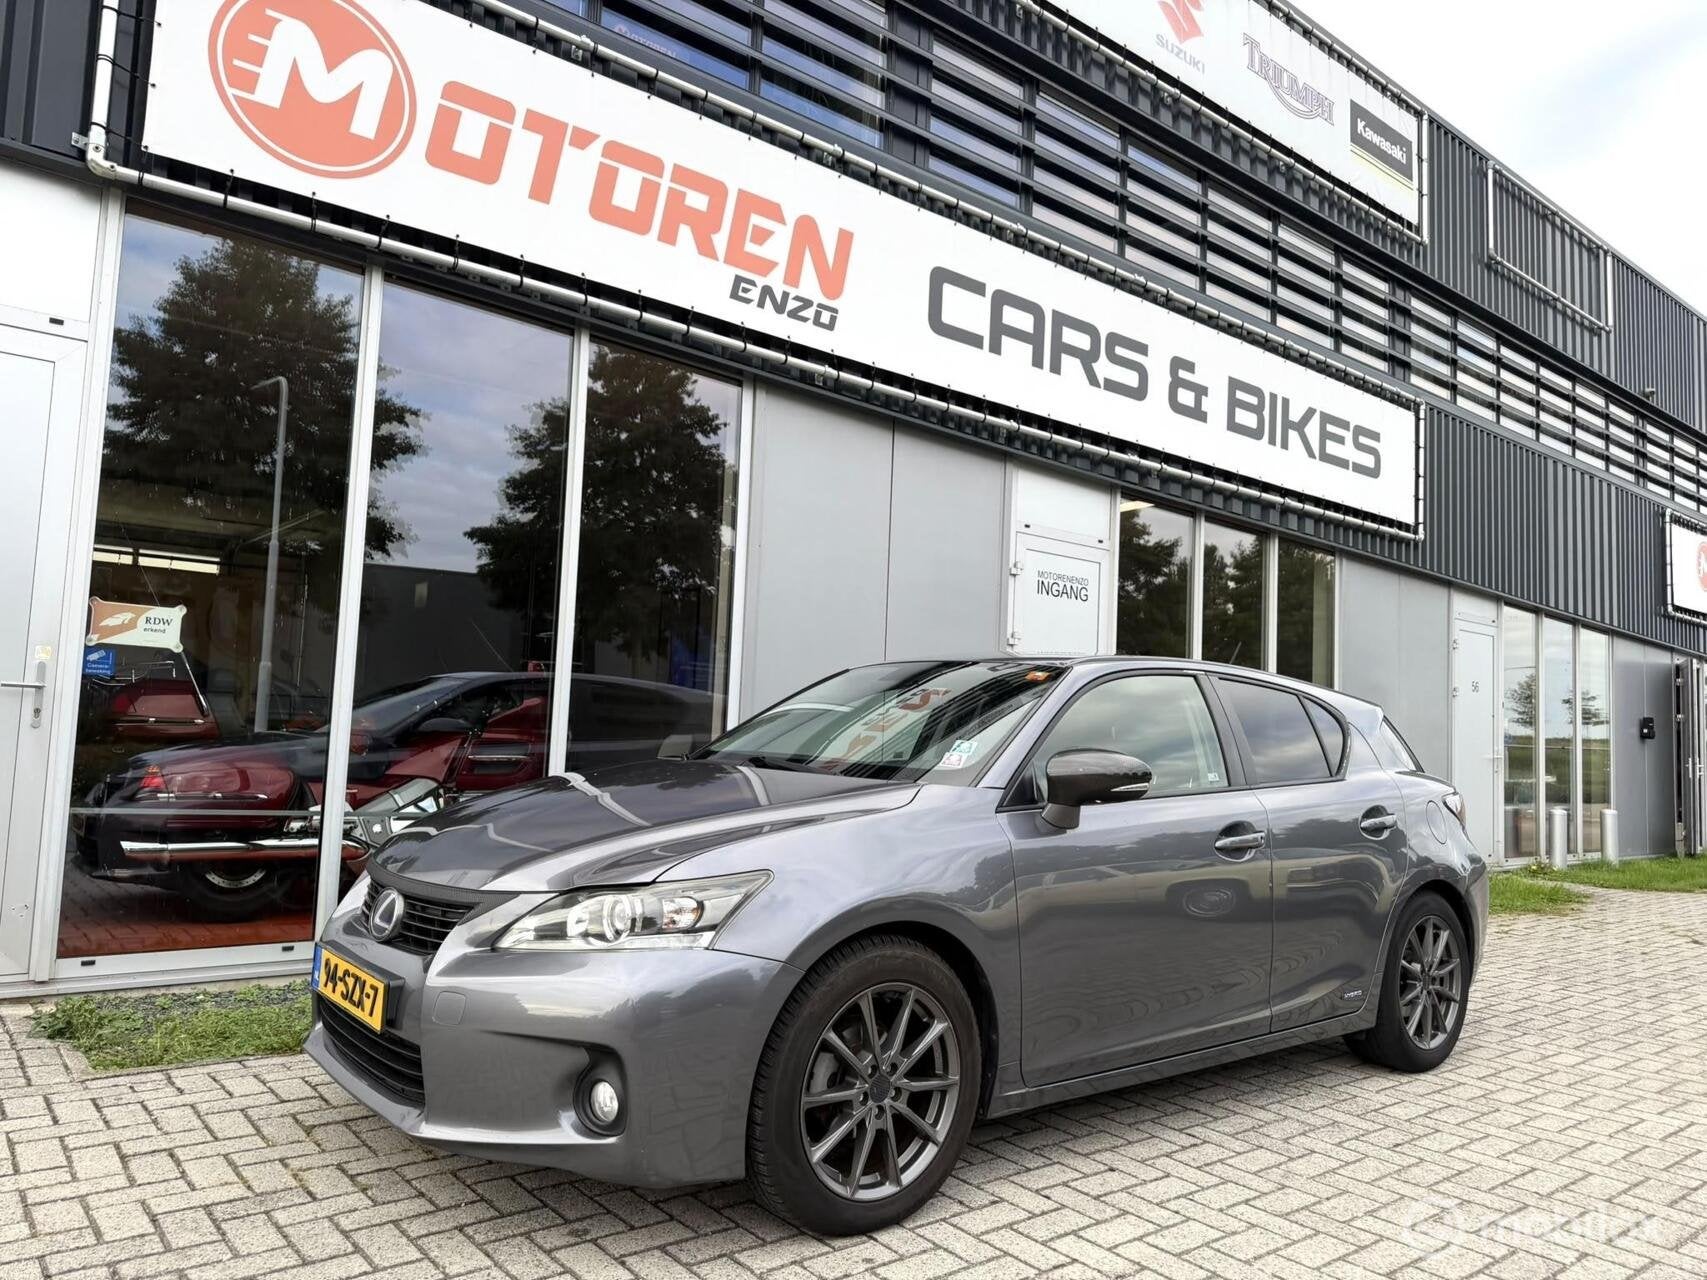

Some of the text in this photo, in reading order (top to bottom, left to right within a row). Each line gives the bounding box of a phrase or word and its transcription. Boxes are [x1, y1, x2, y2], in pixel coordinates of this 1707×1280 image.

[1155, 33, 1206, 74] SUZUKI
[1243, 32, 1335, 126] TRIUMPH
[232, 8, 853, 300] MOTOREN
[1356, 117, 1407, 165] Kawasaki
[729, 274, 839, 332] ENZO
[928, 266, 1381, 480] CARS & BIKES
[1036, 579, 1089, 602] INGANG
[1037, 570, 1089, 586] MOTORENENZO
[144, 616, 173, 626] RDW
[1471, 681, 1480, 693] 56
[324, 958, 379, 1018] 94-SZX-7
